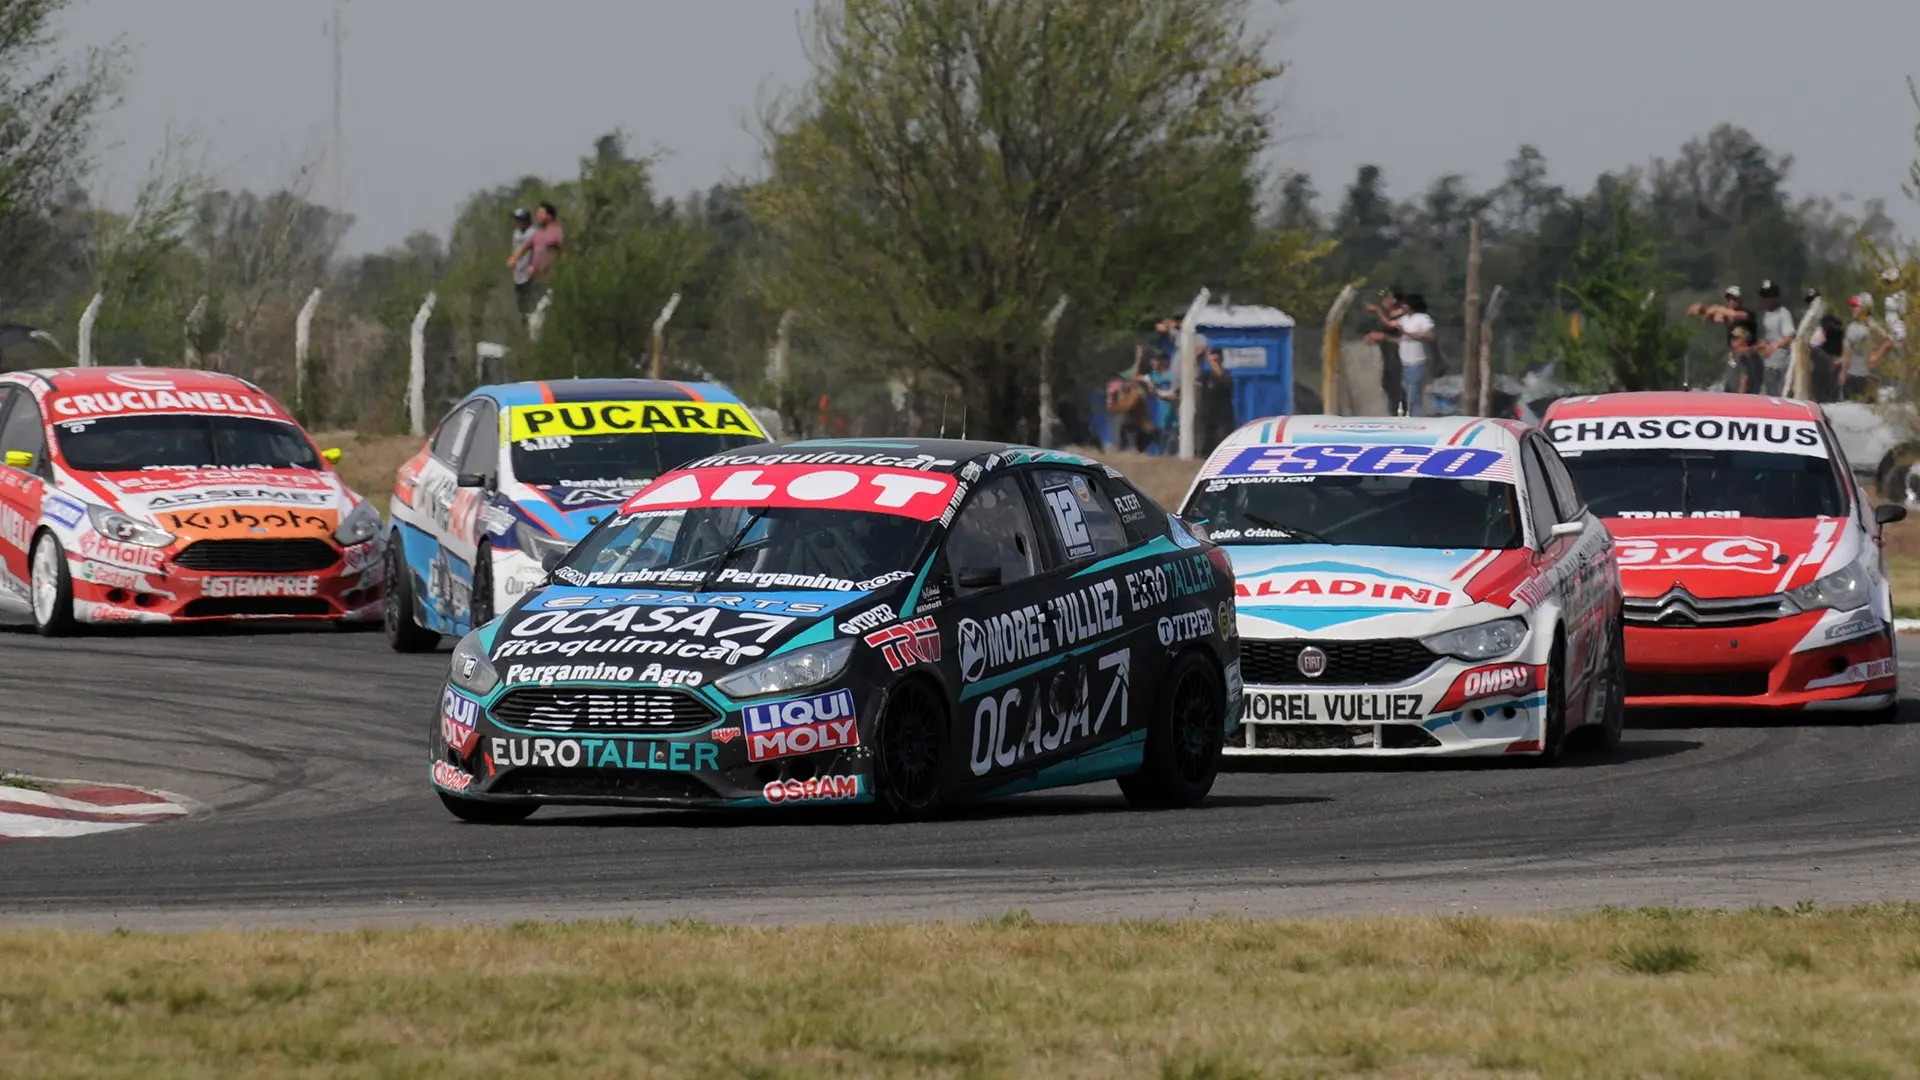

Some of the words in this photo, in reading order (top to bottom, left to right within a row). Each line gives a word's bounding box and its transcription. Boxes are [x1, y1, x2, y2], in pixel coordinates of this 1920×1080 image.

[54, 391, 276, 415] CRUCIANELLI
[522, 405, 752, 433] PUCARA
[1550, 419, 1819, 446] CHASCOMUS
[1220, 445, 1504, 477] ESCO
[629, 470, 948, 507] ALOT
[170, 509, 330, 532] Kubota
[1045, 489, 1089, 548] 12
[1210, 529, 1241, 540] dolfo
[717, 568, 854, 591] Pergamino
[1236, 578, 1452, 606] ALADINI
[511, 605, 720, 637] OCASA
[848, 603, 898, 631] TIPER
[984, 603, 1050, 668] MOREL
[1048, 579, 1124, 647] VULLIEZ
[1172, 608, 1215, 642] TIPER
[863, 614, 942, 672] TRW
[506, 663, 634, 686] Pergamino
[639, 663, 703, 687] Agro
[1304, 655, 1322, 669] FIAT
[1464, 667, 1529, 697] OMBU
[444, 690, 476, 727] QUI
[749, 692, 851, 732] LIQUI
[970, 663, 1089, 777] OCASA
[1243, 694, 1316, 721] MOREL
[1323, 694, 1424, 721] VULLIEZ
[442, 714, 471, 748] OLY
[754, 719, 853, 758] MOLY
[491, 738, 719, 771] EUROTALLER
[764, 775, 857, 803] OSRAM
